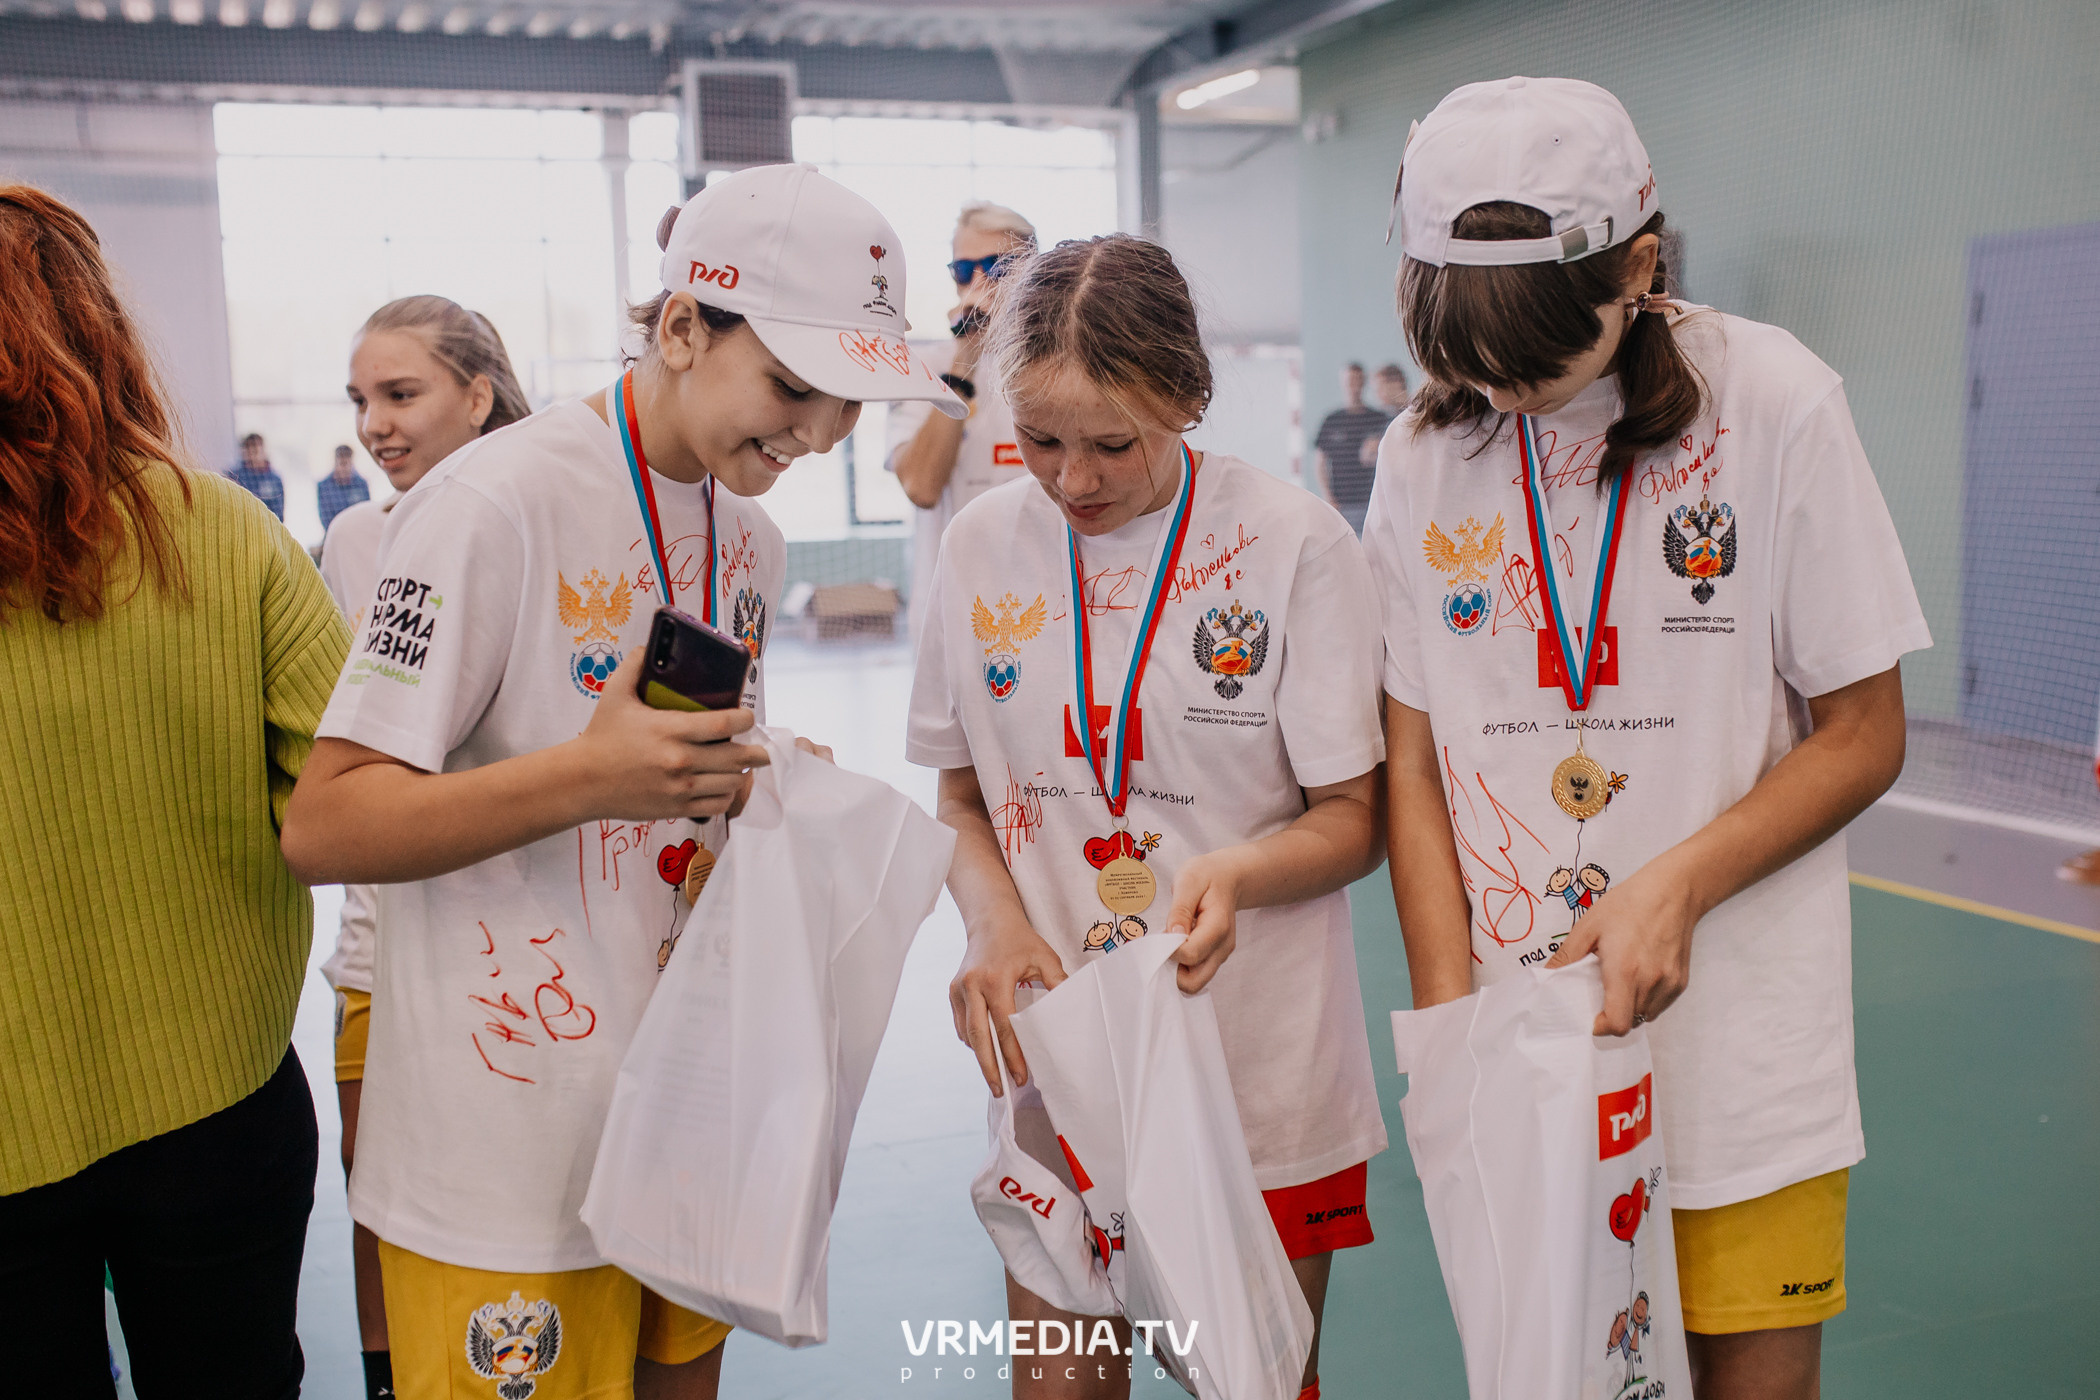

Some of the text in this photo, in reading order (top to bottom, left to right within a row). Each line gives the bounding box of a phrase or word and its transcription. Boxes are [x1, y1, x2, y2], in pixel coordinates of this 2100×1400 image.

[1187, 706, 1266, 719] МИНИСТЕРСТВО СПОРТА
[1183, 715, 1268, 728] РОССИЙСКОЙ ФЕДЕРАЦИИ
[1482, 721, 1539, 736] ФУТБОЛ
[1565, 717, 1616, 731] ШКОЛА
[1619, 717, 1675, 731] ЖИЗНИ
[1149, 789, 1195, 805] ЖИЗНИ
[1519, 947, 1547, 967] ПОД
[1305, 1204, 1364, 1225] 2K SPORT
[1780, 1282, 1803, 1297] 2K
